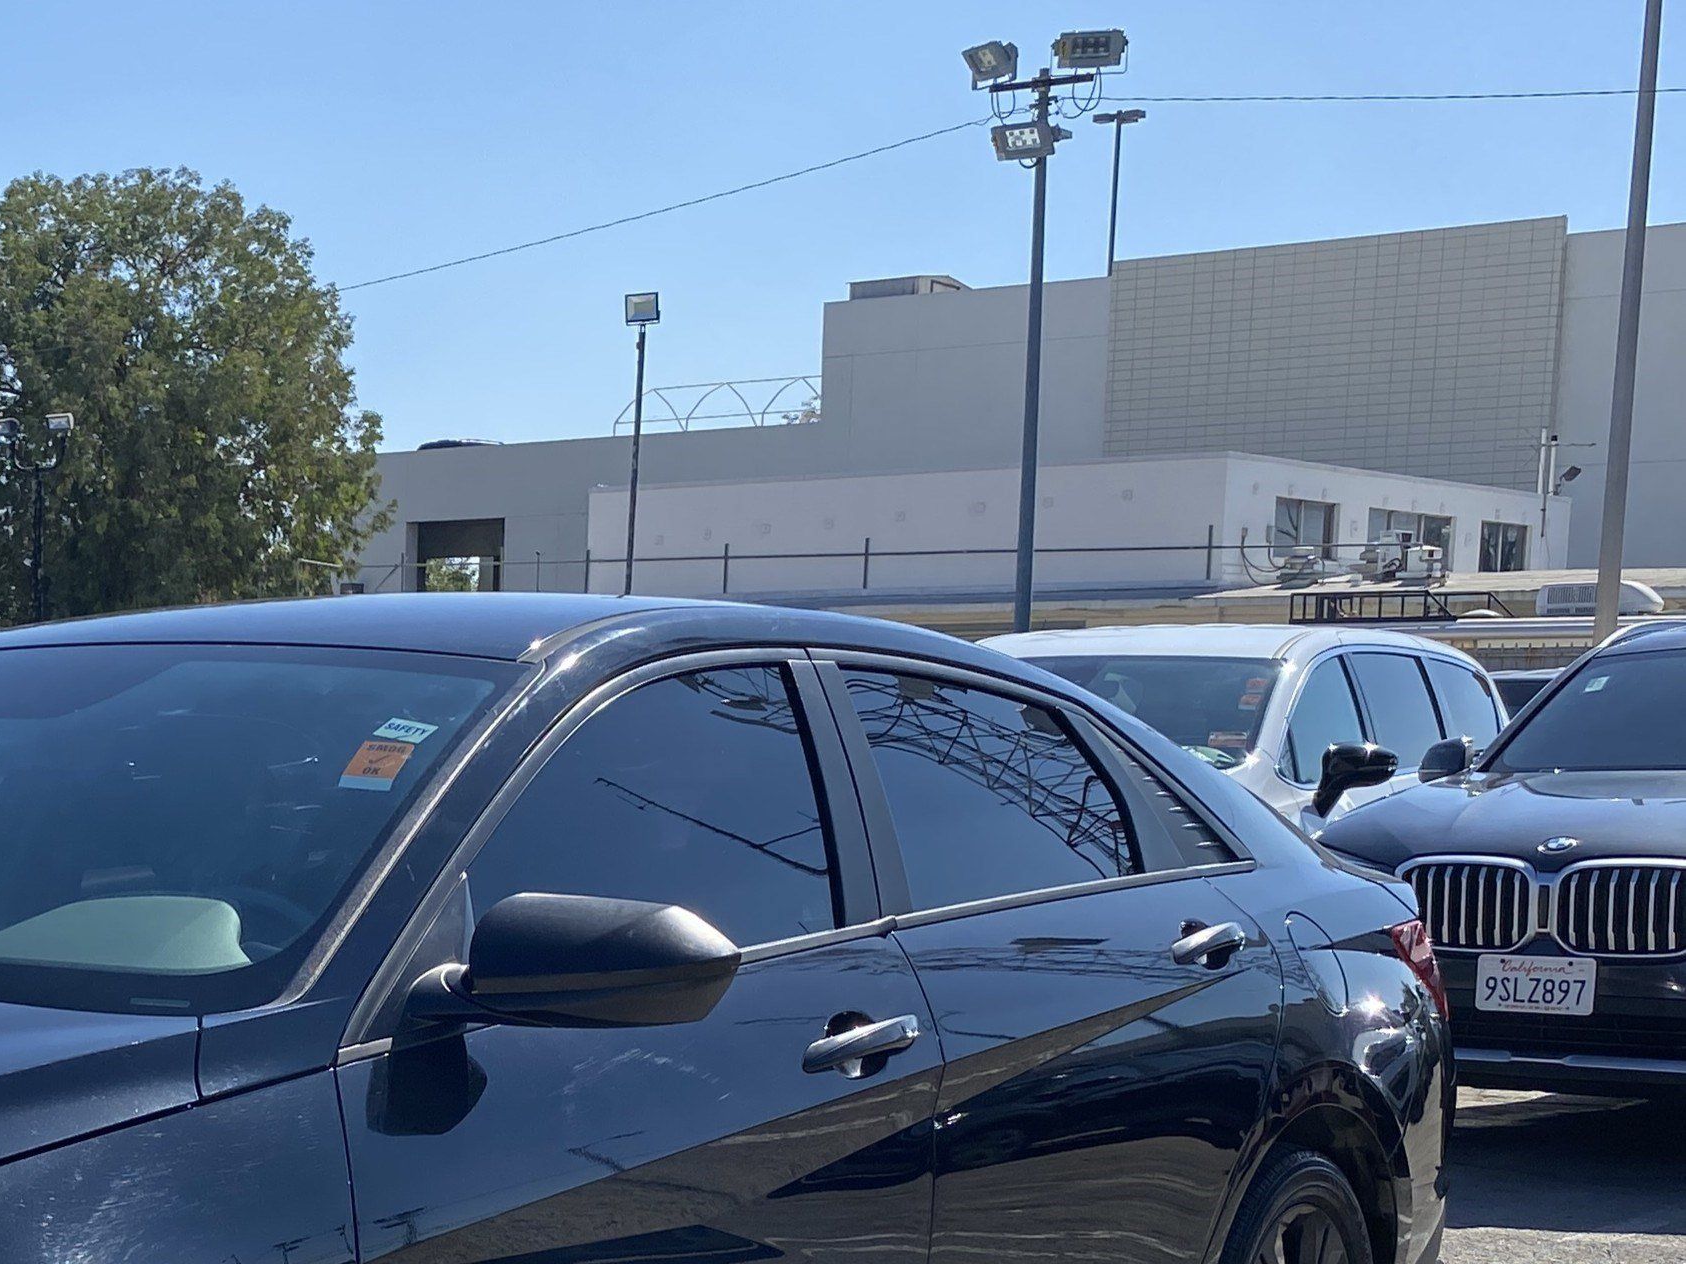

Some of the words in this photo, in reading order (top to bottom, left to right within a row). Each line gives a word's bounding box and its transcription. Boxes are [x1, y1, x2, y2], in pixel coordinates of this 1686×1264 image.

[386, 722, 429, 736] SAFETY
[363, 767, 381, 775] OK
[1501, 960, 1573, 977] California
[1484, 976, 1586, 1006] 9SLZ897
